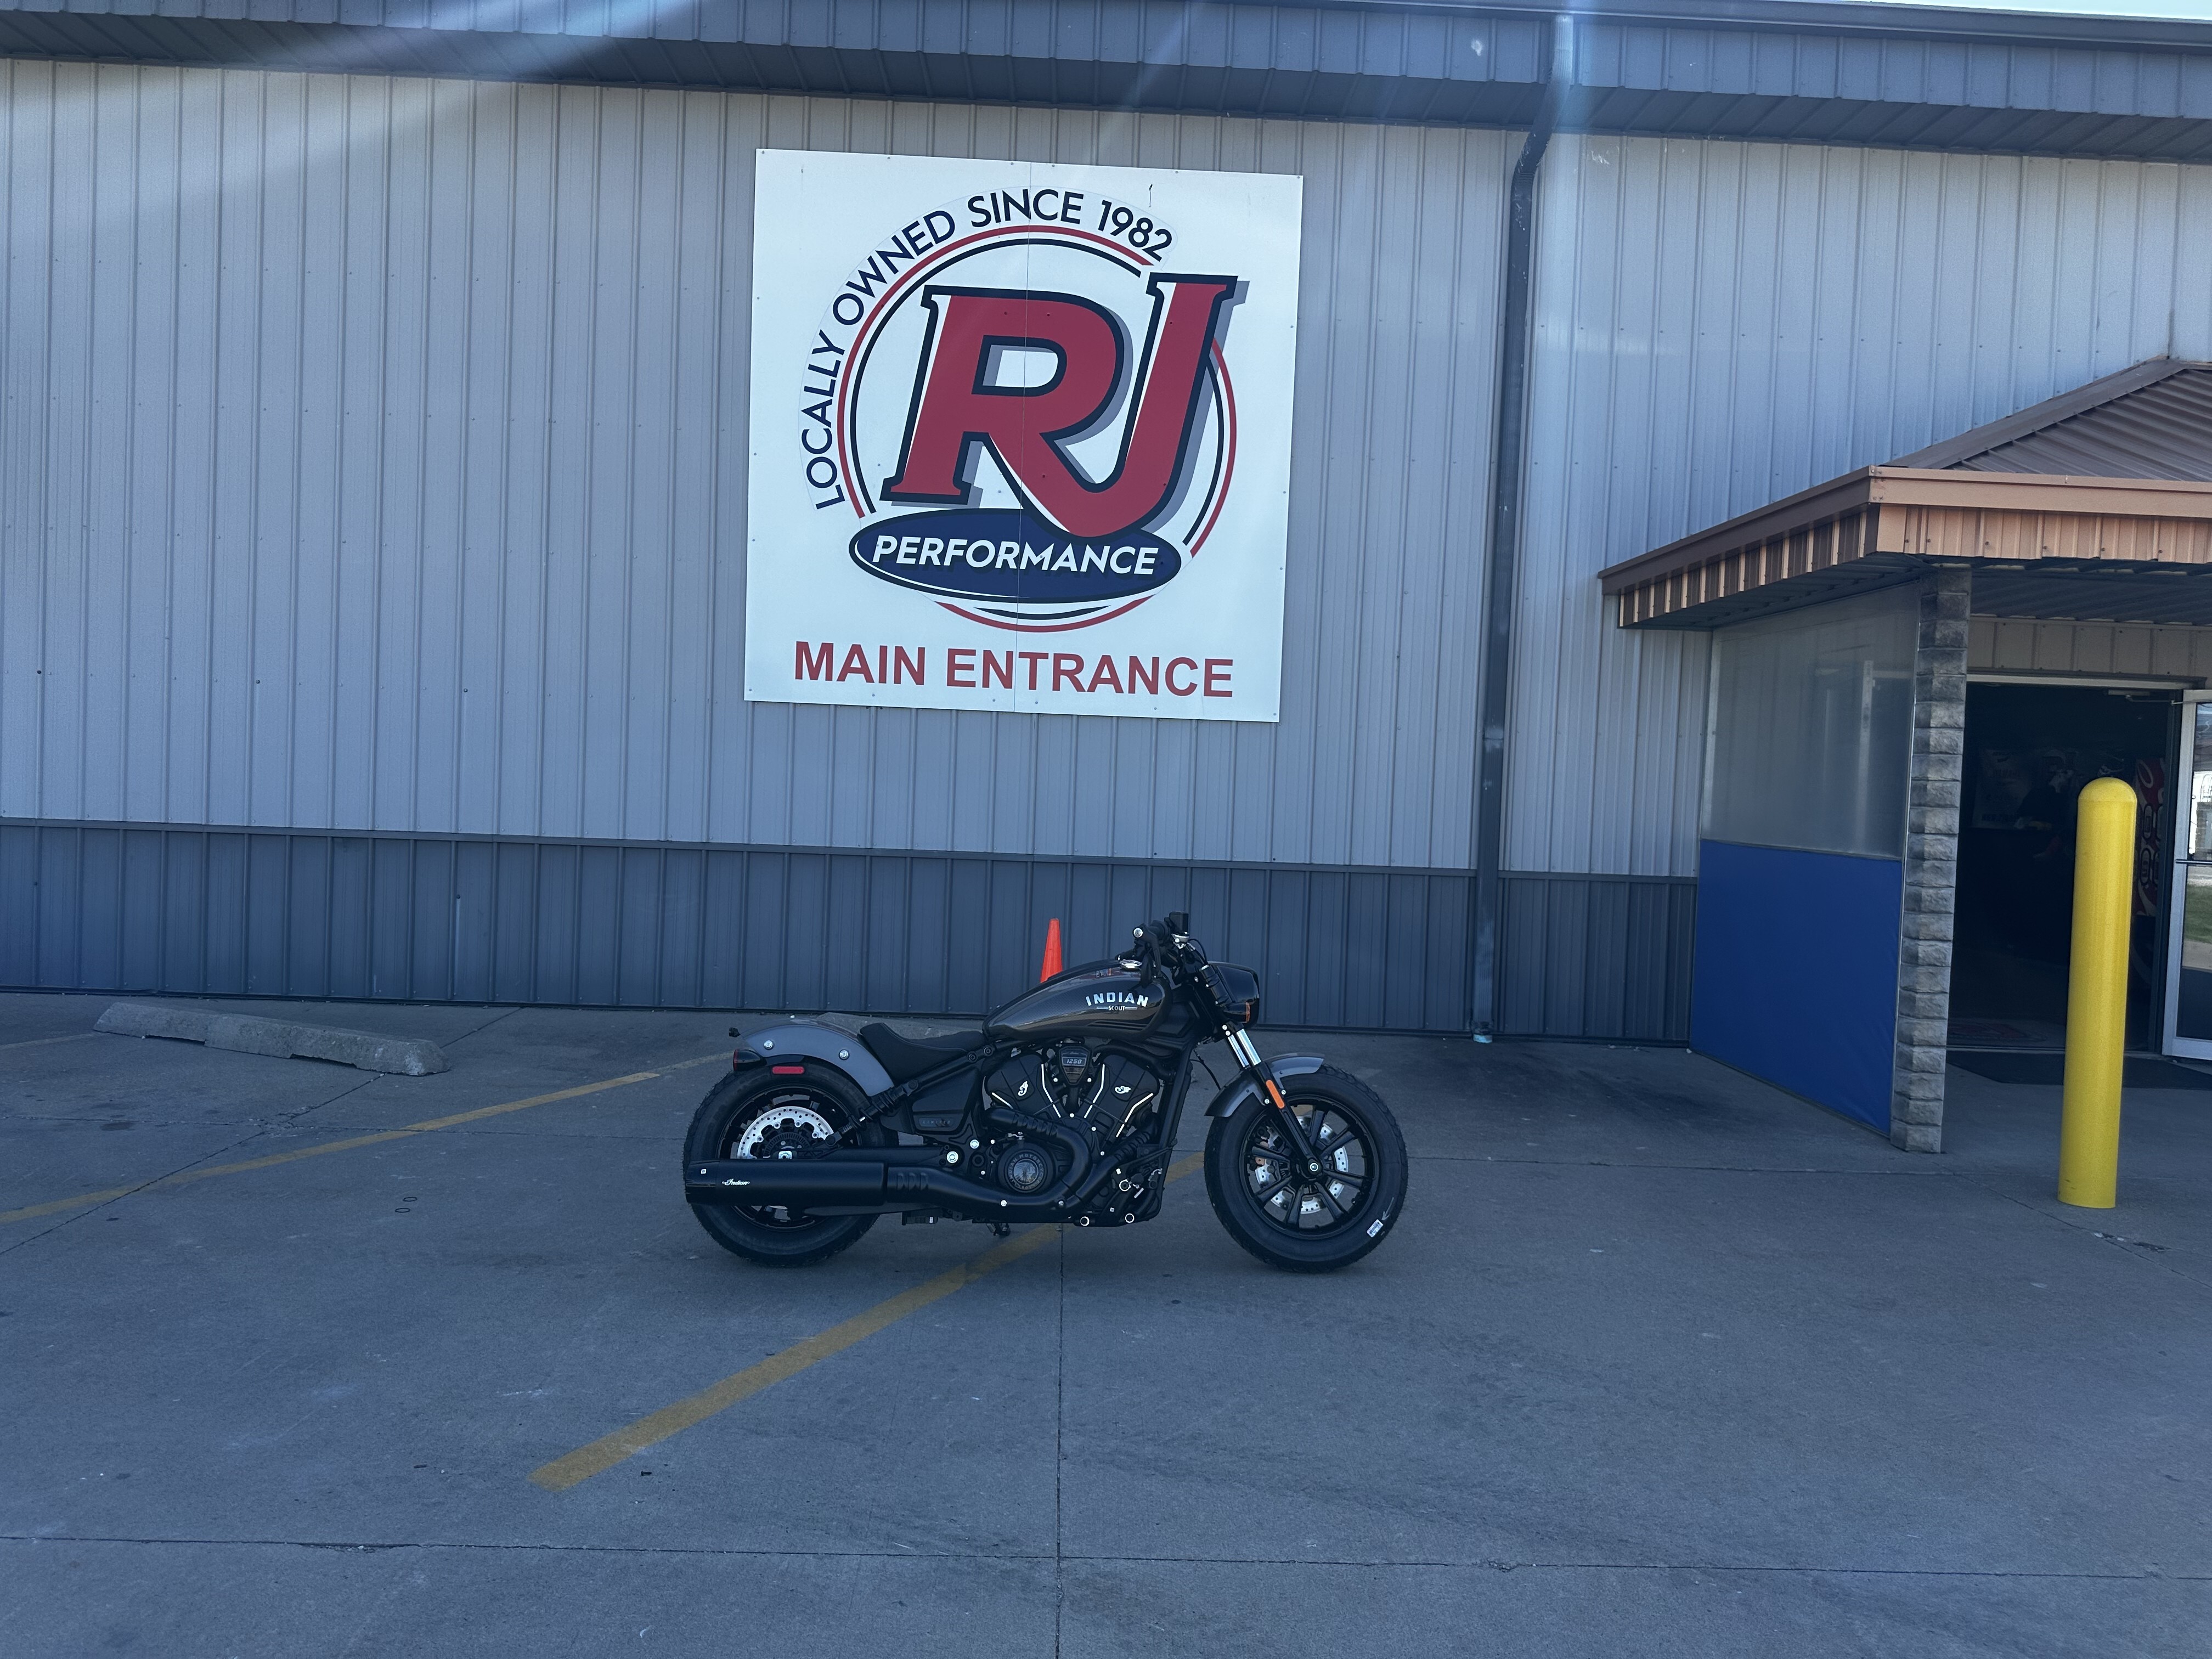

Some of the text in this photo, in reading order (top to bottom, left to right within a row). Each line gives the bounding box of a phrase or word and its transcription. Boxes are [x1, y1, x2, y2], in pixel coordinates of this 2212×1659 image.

[801, 189, 1172, 510] LOCALLY OWNED SINCE 1982
[879, 273, 1250, 540] RJ
[872, 535, 1159, 575] PERFORMANCE
[795, 641, 1232, 697] MAIN ENTRANCE
[1085, 992, 1149, 1007] INDIAN
